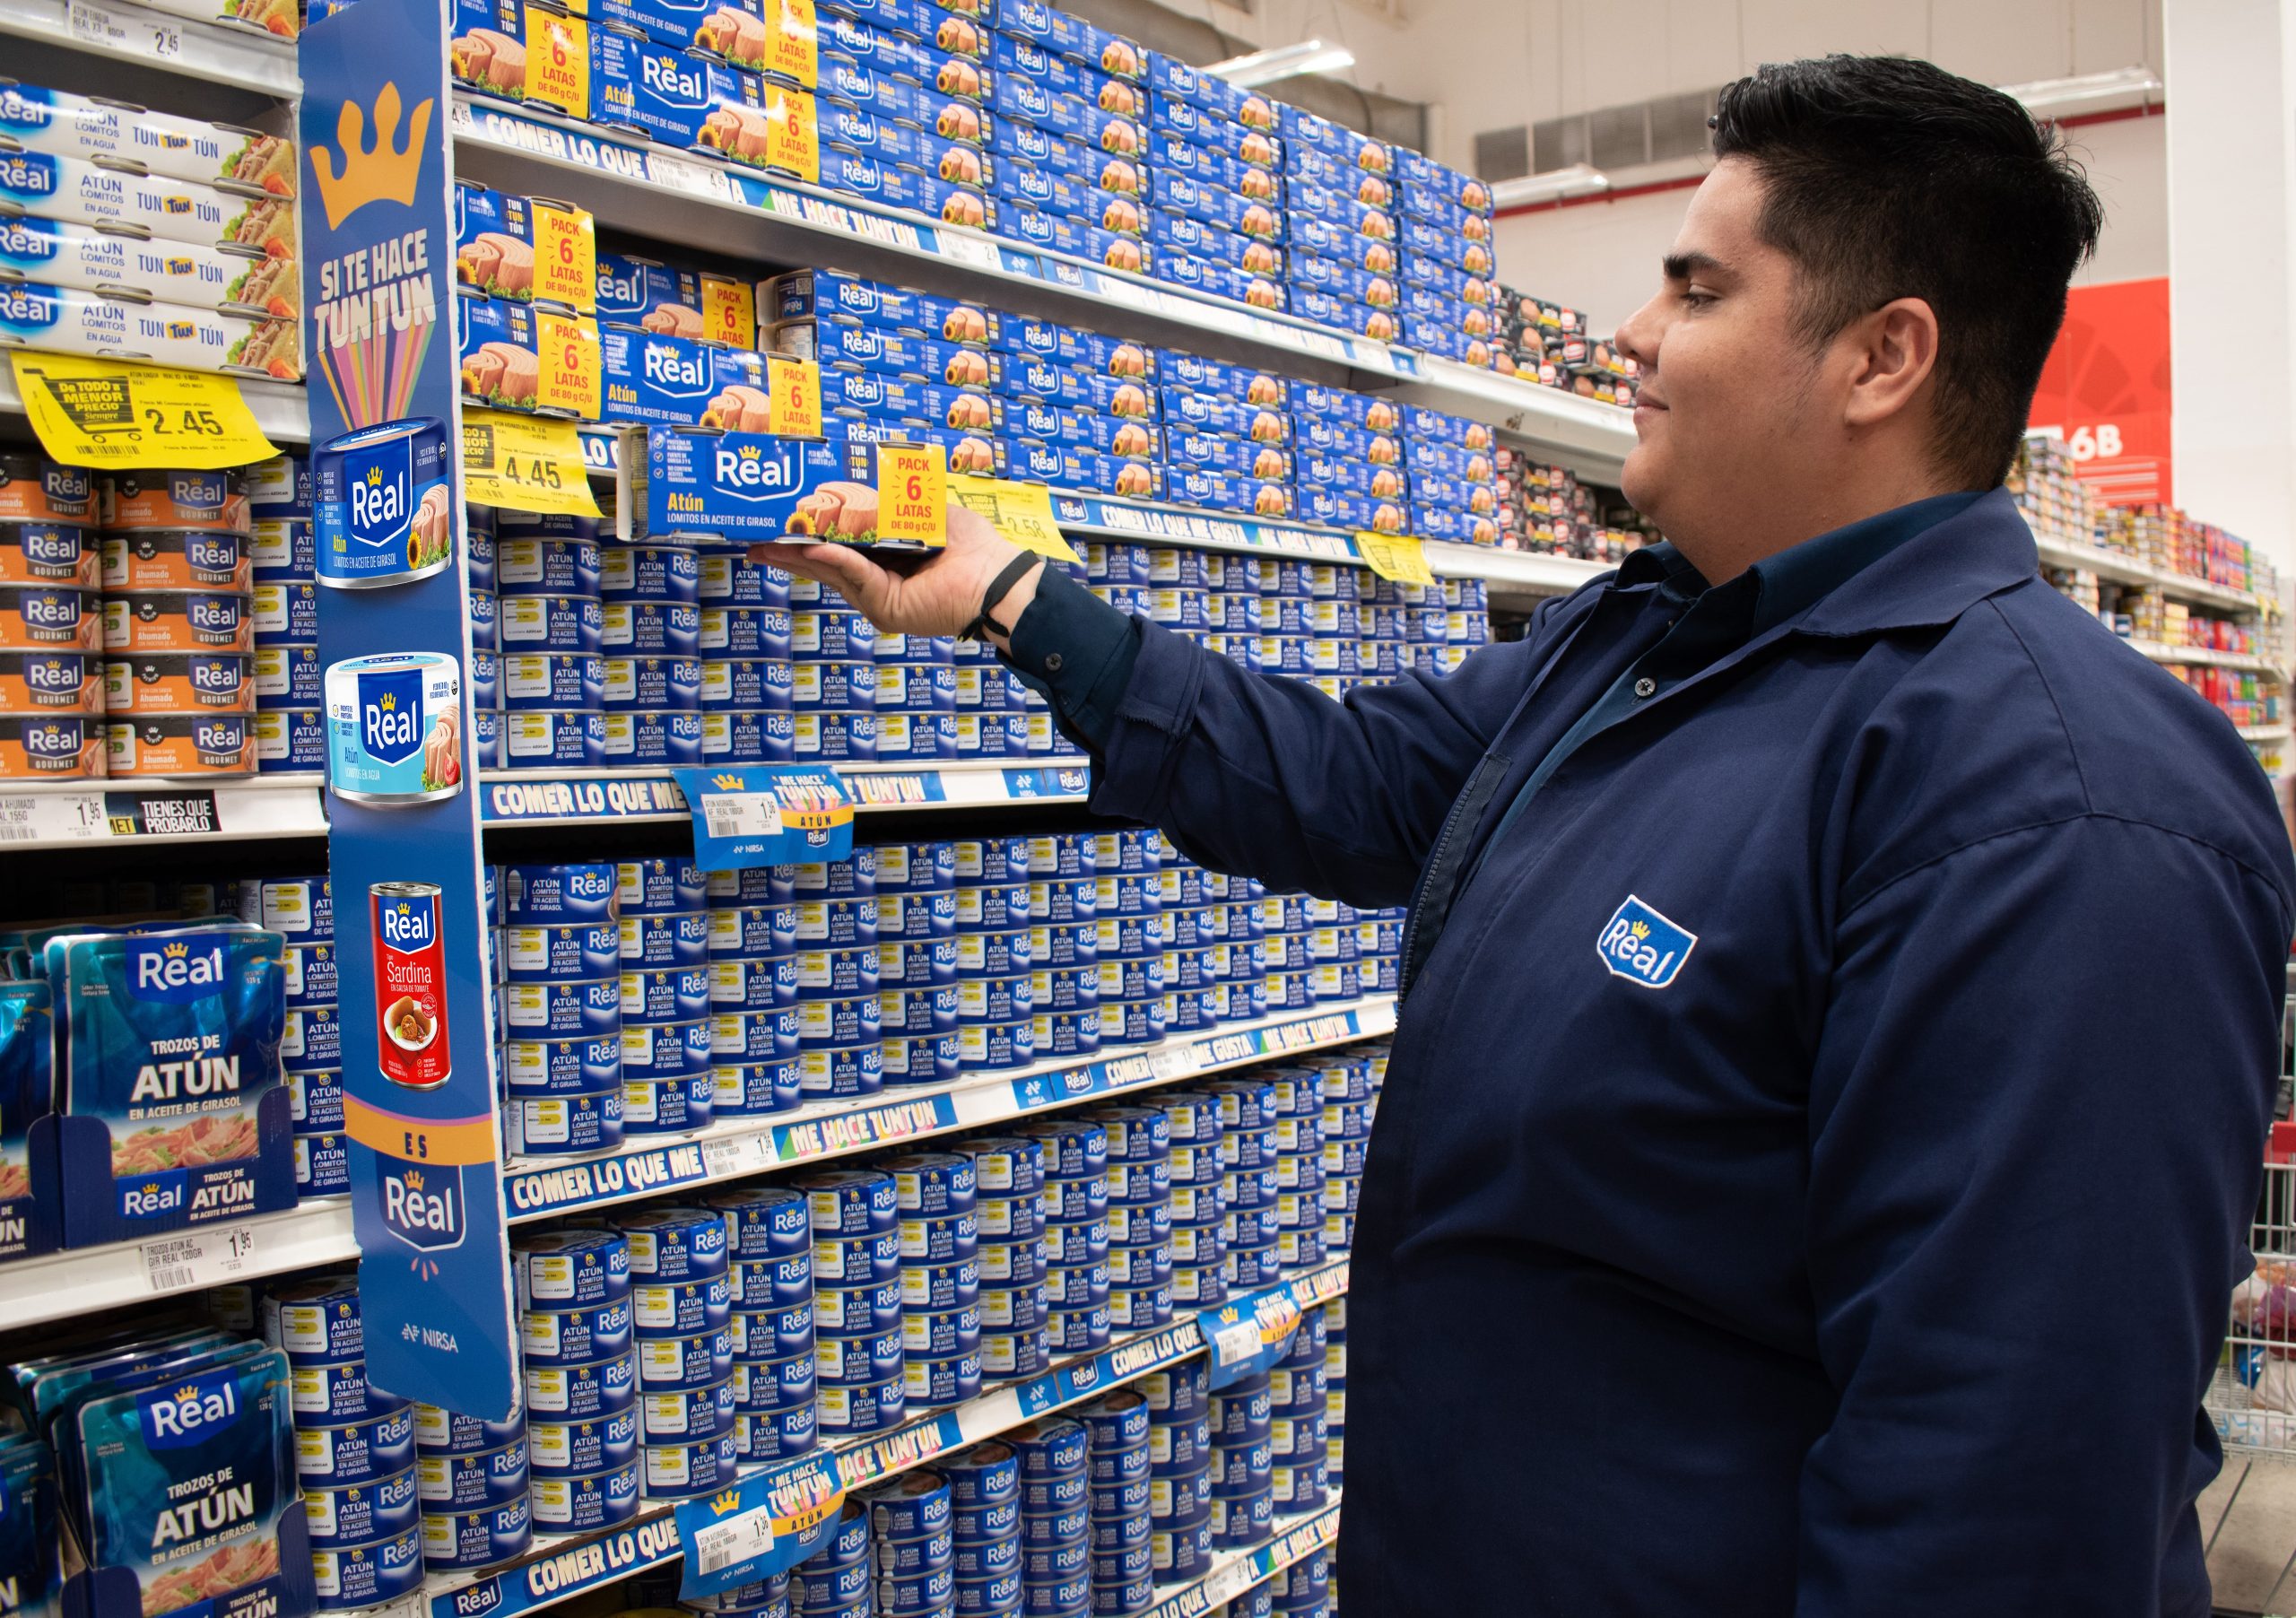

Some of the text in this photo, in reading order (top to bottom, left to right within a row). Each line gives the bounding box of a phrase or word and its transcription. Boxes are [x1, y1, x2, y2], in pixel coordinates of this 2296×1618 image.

[602, 3, 688, 37] LOMITOS EN ACEITE DE GIRASOL
[1019, 4, 1046, 30] Real
[155, 31, 178, 56] 2.45
[642, 55, 702, 100] Real
[837, 67, 868, 94] Real
[1170, 66, 1194, 91] Real
[604, 84, 635, 107] Atún
[486, 114, 645, 180] COMER LO QUE
[82, 174, 122, 192] ATÚN
[843, 159, 875, 186] Real
[81, 189, 124, 204] LOMITOS
[136, 192, 220, 222] TUN TÚN
[770, 188, 801, 213] ME
[803, 195, 851, 228] HACE
[85, 204, 120, 216] EN AGUA
[552, 217, 580, 237] PACK
[559, 239, 573, 265] 6
[321, 228, 429, 302] SI TE HACE
[550, 265, 583, 283] LATAS
[839, 283, 873, 308] Real
[82, 318, 126, 332] LOMITOS
[139, 319, 224, 346] TUN TÚN
[87, 332, 122, 344] EN AGUA
[644, 347, 703, 386] Real
[78, 381, 110, 392] TODO
[1028, 367, 1055, 391] Real
[63, 393, 124, 403] MENOR
[608, 383, 638, 404] Atún
[74, 403, 119, 412] PRECIO
[84, 412, 118, 421] Siempre
[145, 409, 224, 437] 2.45
[850, 446, 866, 457] TUN
[2070, 424, 2124, 462] 6B
[505, 456, 561, 490] 4.45
[717, 450, 791, 487] Real
[851, 457, 866, 467] TUN
[851, 466, 867, 479] TÚN
[898, 457, 929, 472] PACK
[174, 479, 221, 502] Real
[906, 475, 922, 501] 6
[1186, 474, 1210, 495] Real
[352, 470, 404, 530] Real
[667, 492, 704, 512] Atún
[896, 504, 932, 518] LATAS
[1314, 494, 1334, 515] Real
[667, 513, 777, 528] LOMITOS EN ACEITE DE GIRASOL
[891, 521, 900, 531] DE
[901, 521, 914, 532] 80
[922, 521, 936, 532] C/U
[1060, 503, 1248, 544] Real COMER LO QUE ME GUSTA
[192, 543, 234, 565] Real
[333, 535, 347, 553] Atún
[370, 555, 377, 568] DE
[377, 552, 397, 567] GIRASOL
[547, 552, 574, 564] ATÚN
[135, 570, 170, 579] Ahumado
[197, 572, 231, 583] GOURMET
[765, 613, 790, 632] Real
[195, 666, 238, 689] Real
[201, 694, 235, 704] GOURMET
[365, 700, 417, 750] Real
[557, 723, 583, 735] ATÚN
[344, 747, 358, 763] Atún
[778, 775, 823, 786] ME HACE
[853, 777, 926, 804] TUNTUN
[5, 799, 36, 810] AHUMADO
[142, 800, 212, 818] TIENES QUE
[493, 782, 651, 815] COMER LO QUE
[11, 803, 100, 826] 155G 1.95
[145, 816, 211, 833] PROBARLO
[800, 814, 831, 827] ATÚN
[808, 830, 827, 843] Real
[745, 845, 764, 853] NIRSA
[532, 874, 610, 896] ATÚN Real
[385, 909, 429, 942] Real
[1602, 918, 1675, 981] Real
[138, 947, 224, 991] Real
[387, 961, 432, 985] Sardina
[151, 1034, 220, 1055] TROZOS DE
[1213, 1034, 1255, 1062] GUSTA
[130, 1046, 239, 1103] ATÚN
[1105, 1058, 1152, 1086] COMER
[129, 1096, 242, 1120] EN ACEITE DE GIRASOL
[790, 1100, 939, 1153] ME HACE TUNTUN
[513, 1167, 593, 1209] COMER
[593, 1160, 624, 1194] LO
[625, 1153, 669, 1191] QUE
[670, 1146, 703, 1177] ME
[124, 1176, 256, 1215] Real ATÚN
[385, 1176, 455, 1232] Real
[147, 1239, 194, 1257] TROZOS ATUN AC
[230, 1232, 251, 1257] 1.95
[148, 1248, 203, 1267] GIR REAL 120GR
[422, 1327, 458, 1353] NIRSA
[1072, 1323, 1201, 1387] Real COMER LO QUE
[151, 1382, 235, 1438] Real
[874, 1422, 944, 1469] TUNTUN
[152, 1482, 255, 1549] ATÚN
[344, 1533, 419, 1575] ATÚN Real
[527, 1544, 604, 1596] COMER
[605, 1534, 635, 1564] LO
[638, 1518, 681, 1560] QUE
[457, 1585, 497, 1614] Real
